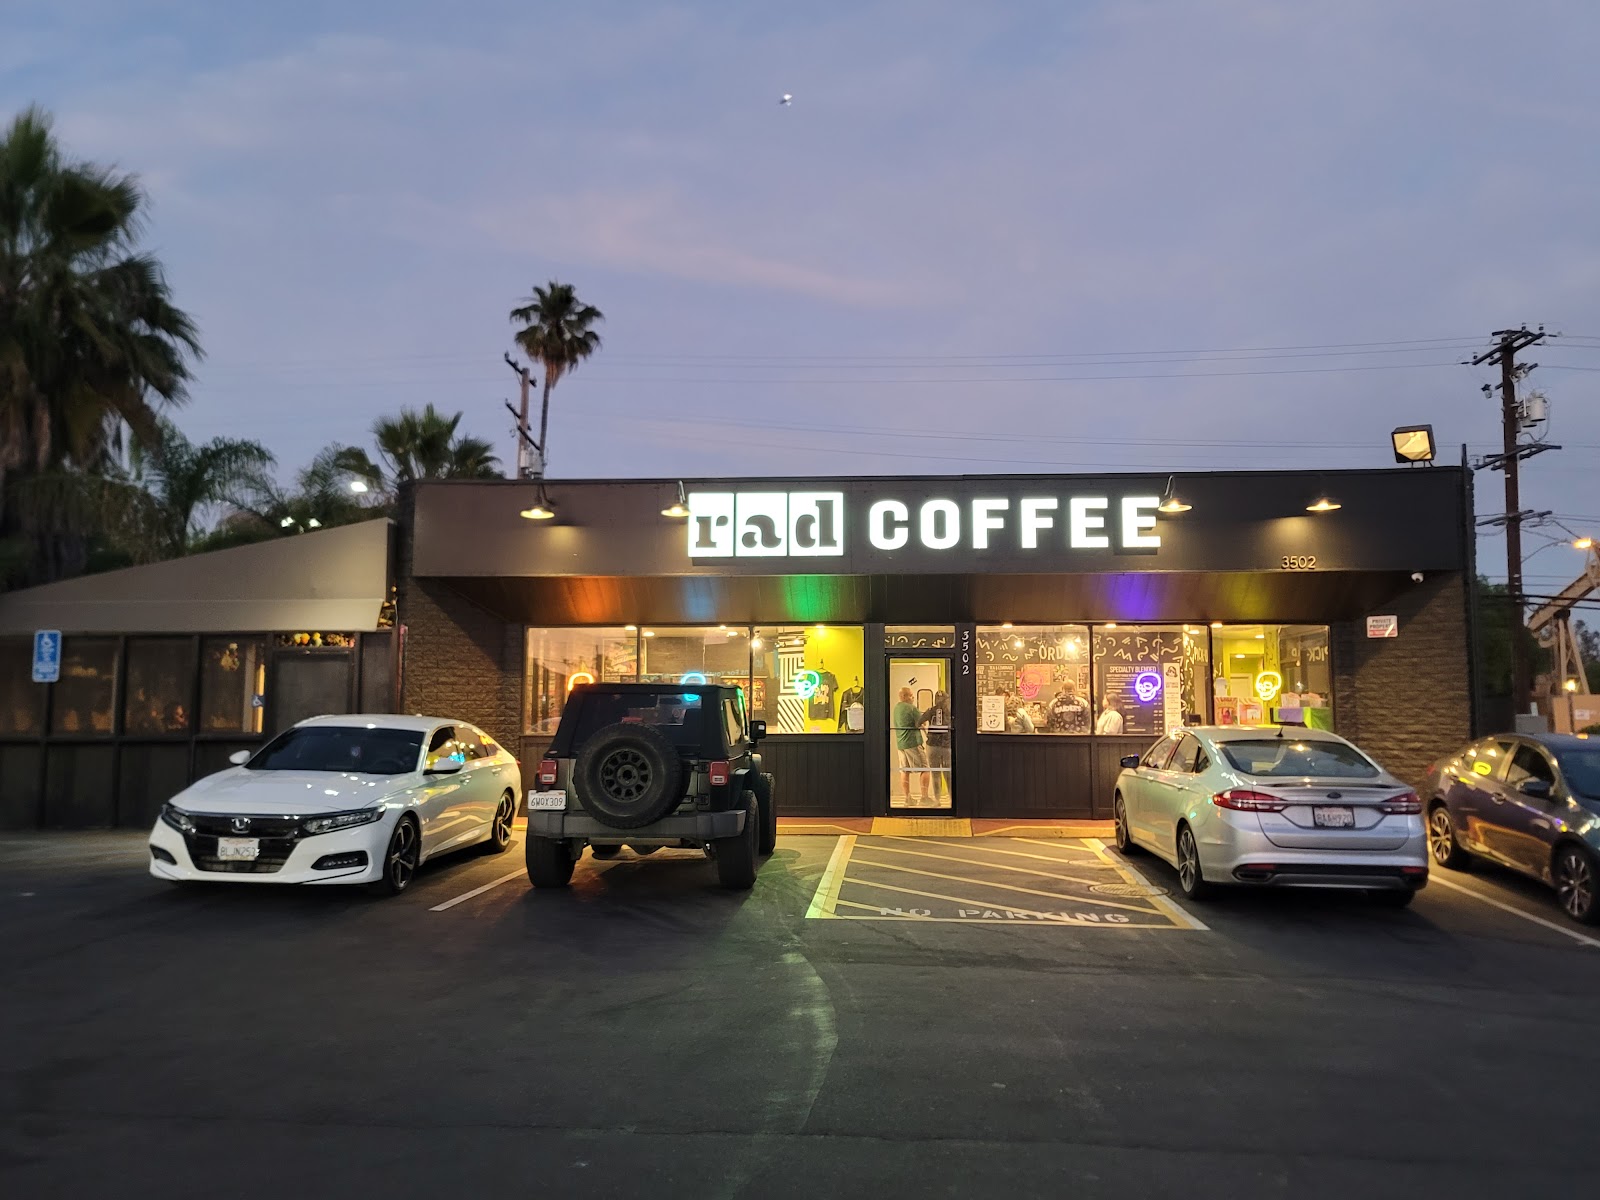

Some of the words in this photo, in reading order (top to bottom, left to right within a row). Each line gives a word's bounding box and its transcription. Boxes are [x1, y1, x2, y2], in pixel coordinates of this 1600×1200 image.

[695, 499, 838, 549] rad
[868, 496, 1162, 550] COFFEE
[1281, 555, 1317, 569] 3502
[961, 630, 970, 675] 3502
[1038, 645, 1080, 661] ORDER
[879, 907, 932, 917] NO
[957, 909, 1130, 923] PARKING
